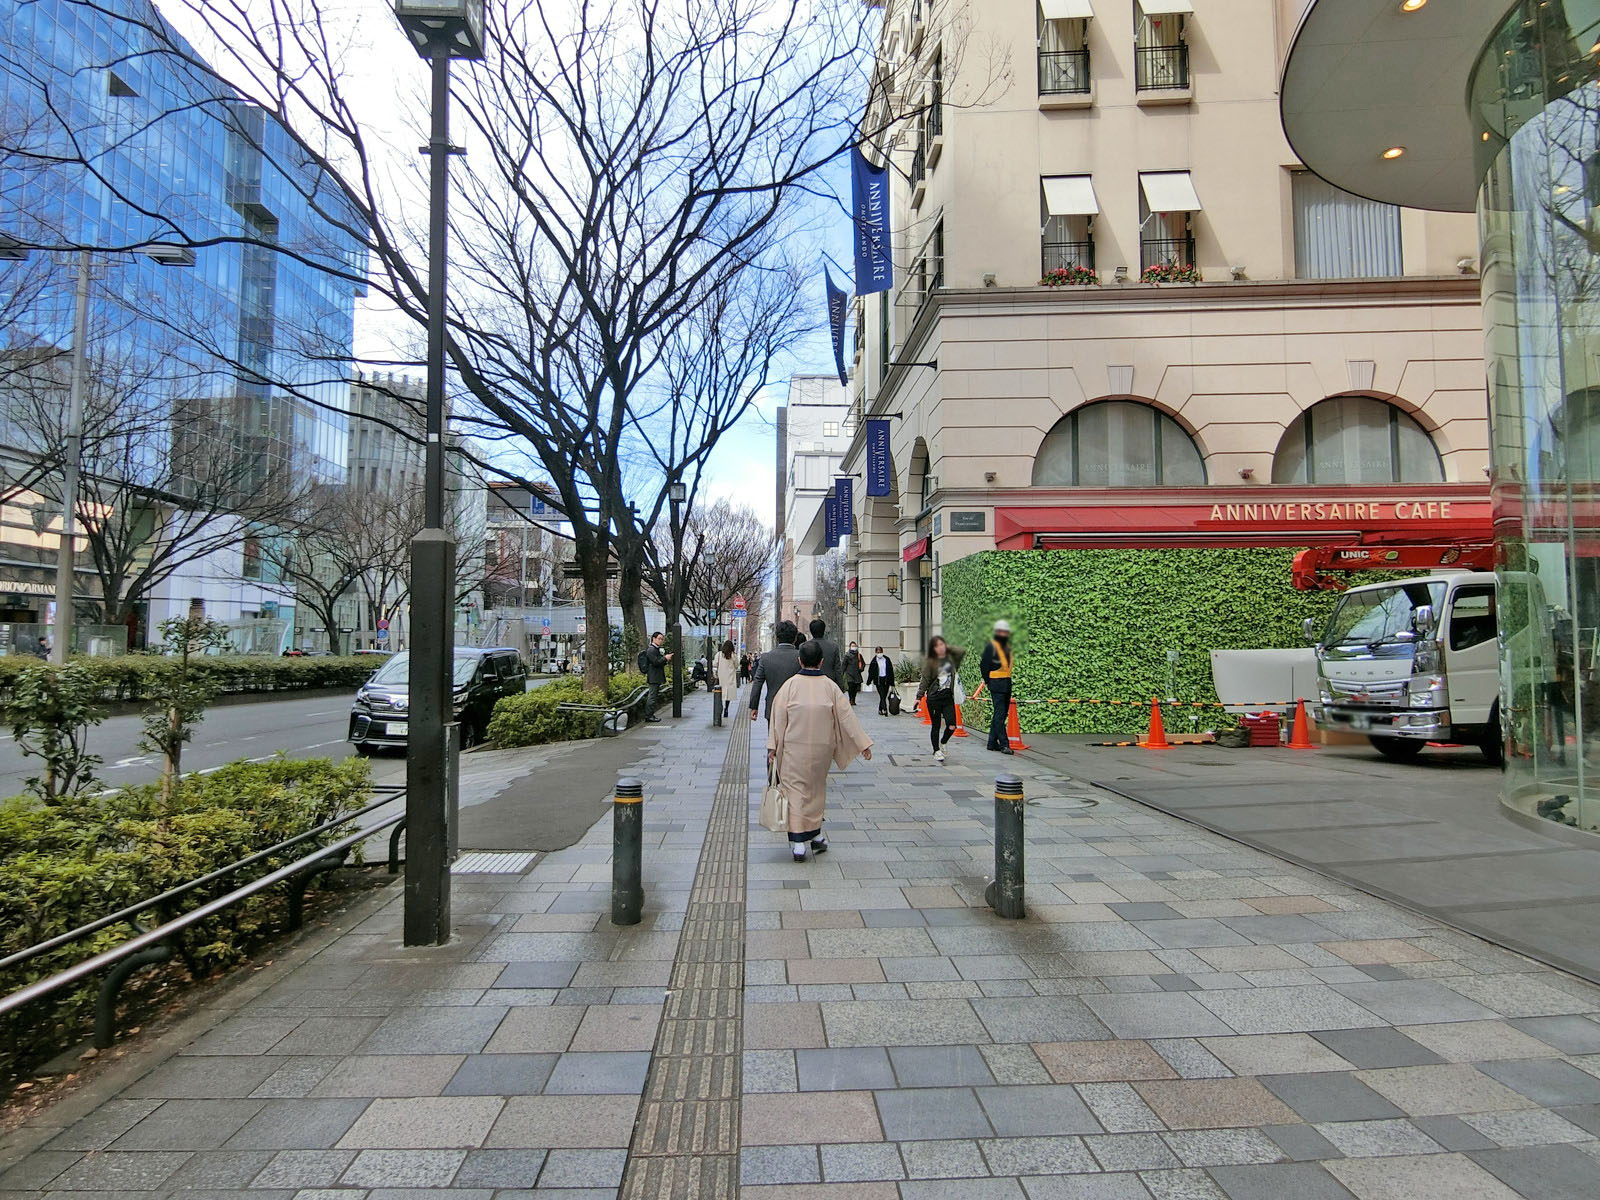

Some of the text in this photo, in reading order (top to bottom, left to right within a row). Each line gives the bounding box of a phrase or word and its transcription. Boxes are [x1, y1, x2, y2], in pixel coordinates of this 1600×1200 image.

[860, 204, 868, 258] OMOTANDO
[868, 183, 885, 281] ANNIVERSAIRE
[875, 429, 885, 488] ANNIVERSAIRE
[1210, 501, 1452, 521] ANNIVERSAIRE CAFE
[1340, 550, 1370, 559] UNIC
[26, 583, 56, 594] ARMAN
